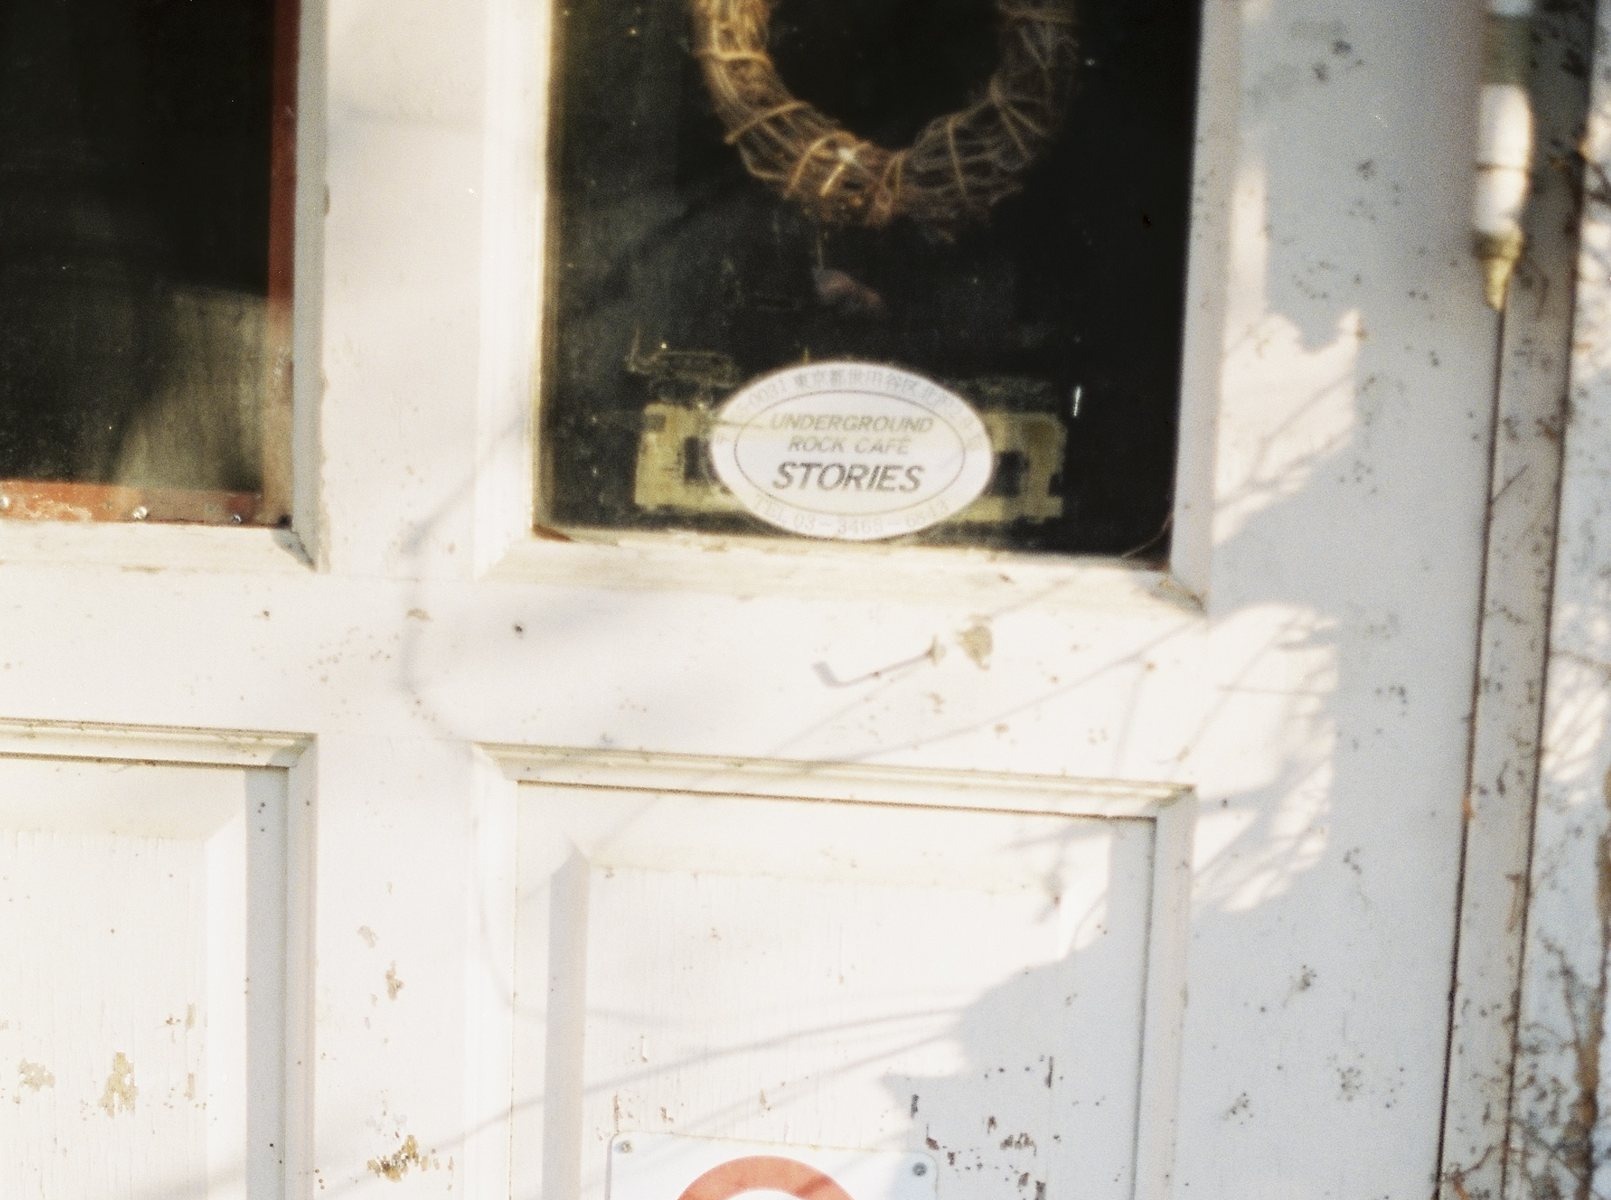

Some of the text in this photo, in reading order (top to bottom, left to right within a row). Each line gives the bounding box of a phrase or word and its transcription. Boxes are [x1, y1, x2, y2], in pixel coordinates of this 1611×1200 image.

[769, 412, 934, 433] UNDERGROUND
[787, 435, 847, 453] ROCK
[772, 461, 925, 492] STORIES
